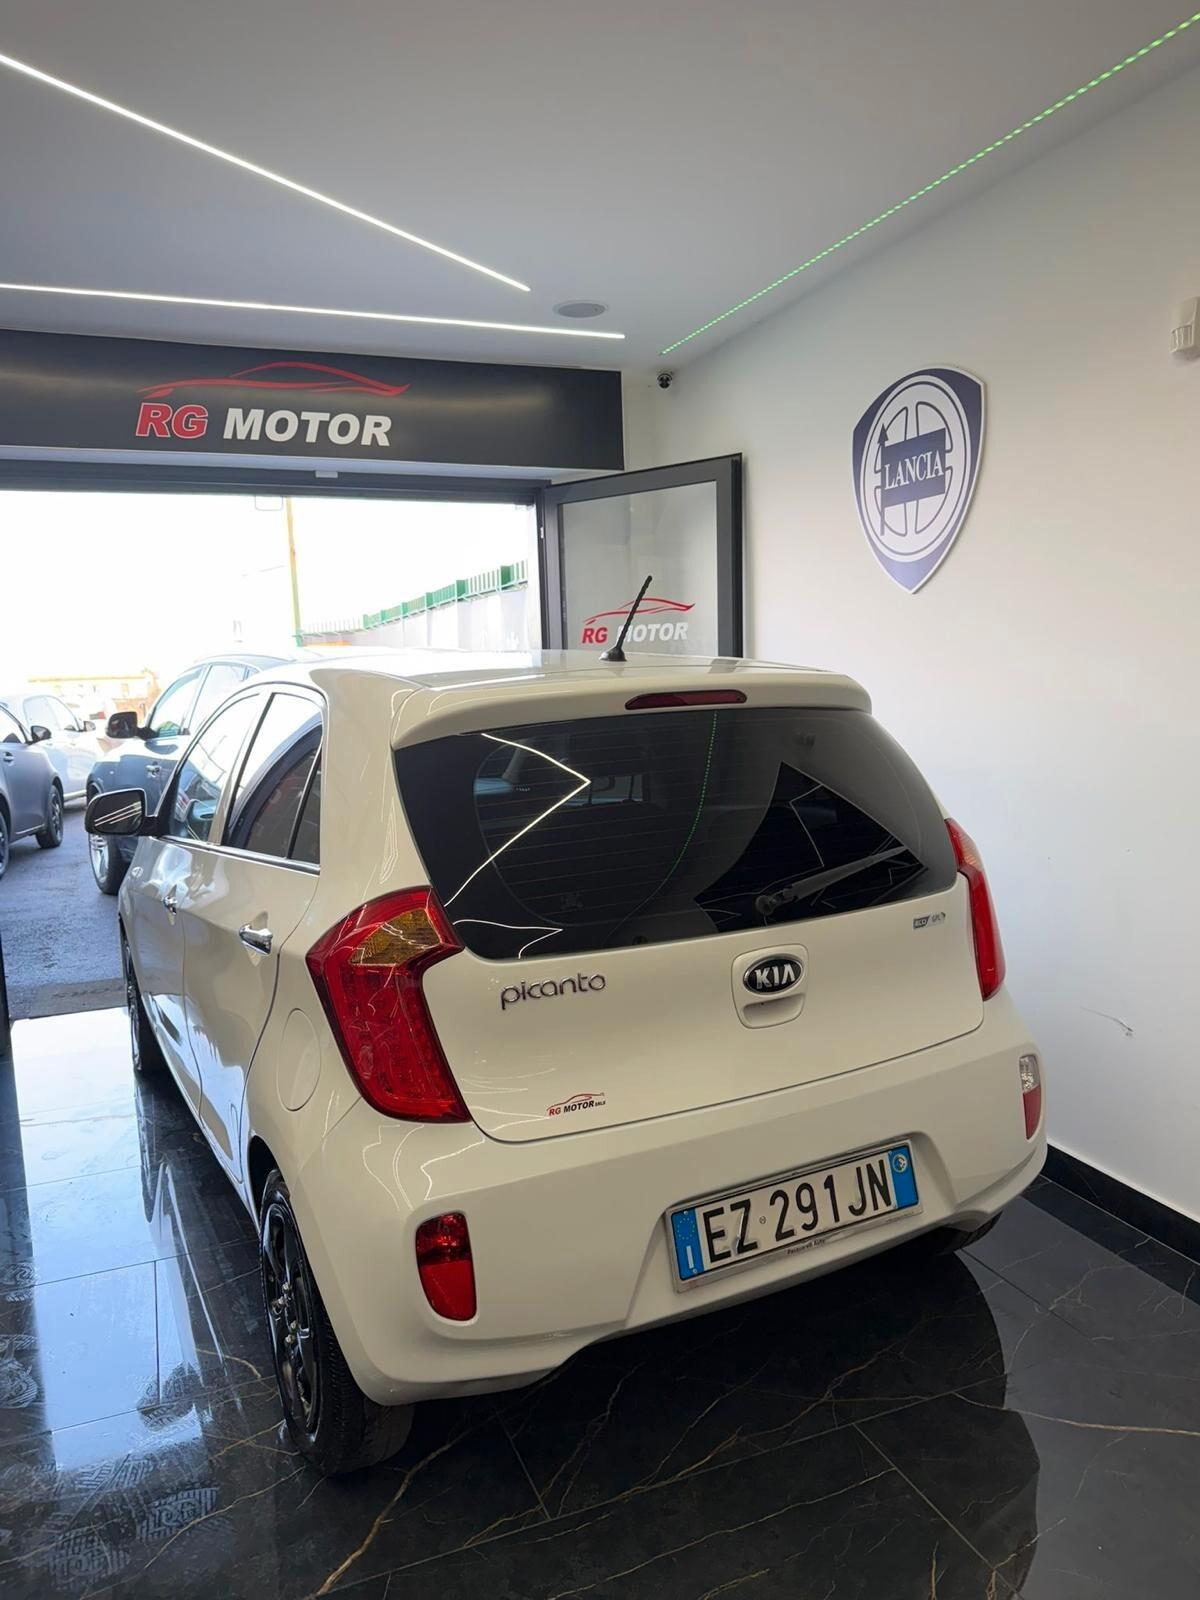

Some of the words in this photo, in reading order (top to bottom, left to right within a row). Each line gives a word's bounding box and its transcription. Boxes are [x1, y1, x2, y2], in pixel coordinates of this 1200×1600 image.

[135, 402, 209, 439] RG
[223, 407, 393, 447] MOTOR
[884, 450, 945, 491] LANCIA
[581, 627, 608, 644] RG
[500, 972, 607, 1011] picanto
[755, 963, 796, 989] KIA
[549, 1107, 561, 1116] RG
[564, 1100, 595, 1113] MOTOR
[702, 1198, 758, 1264] EZ
